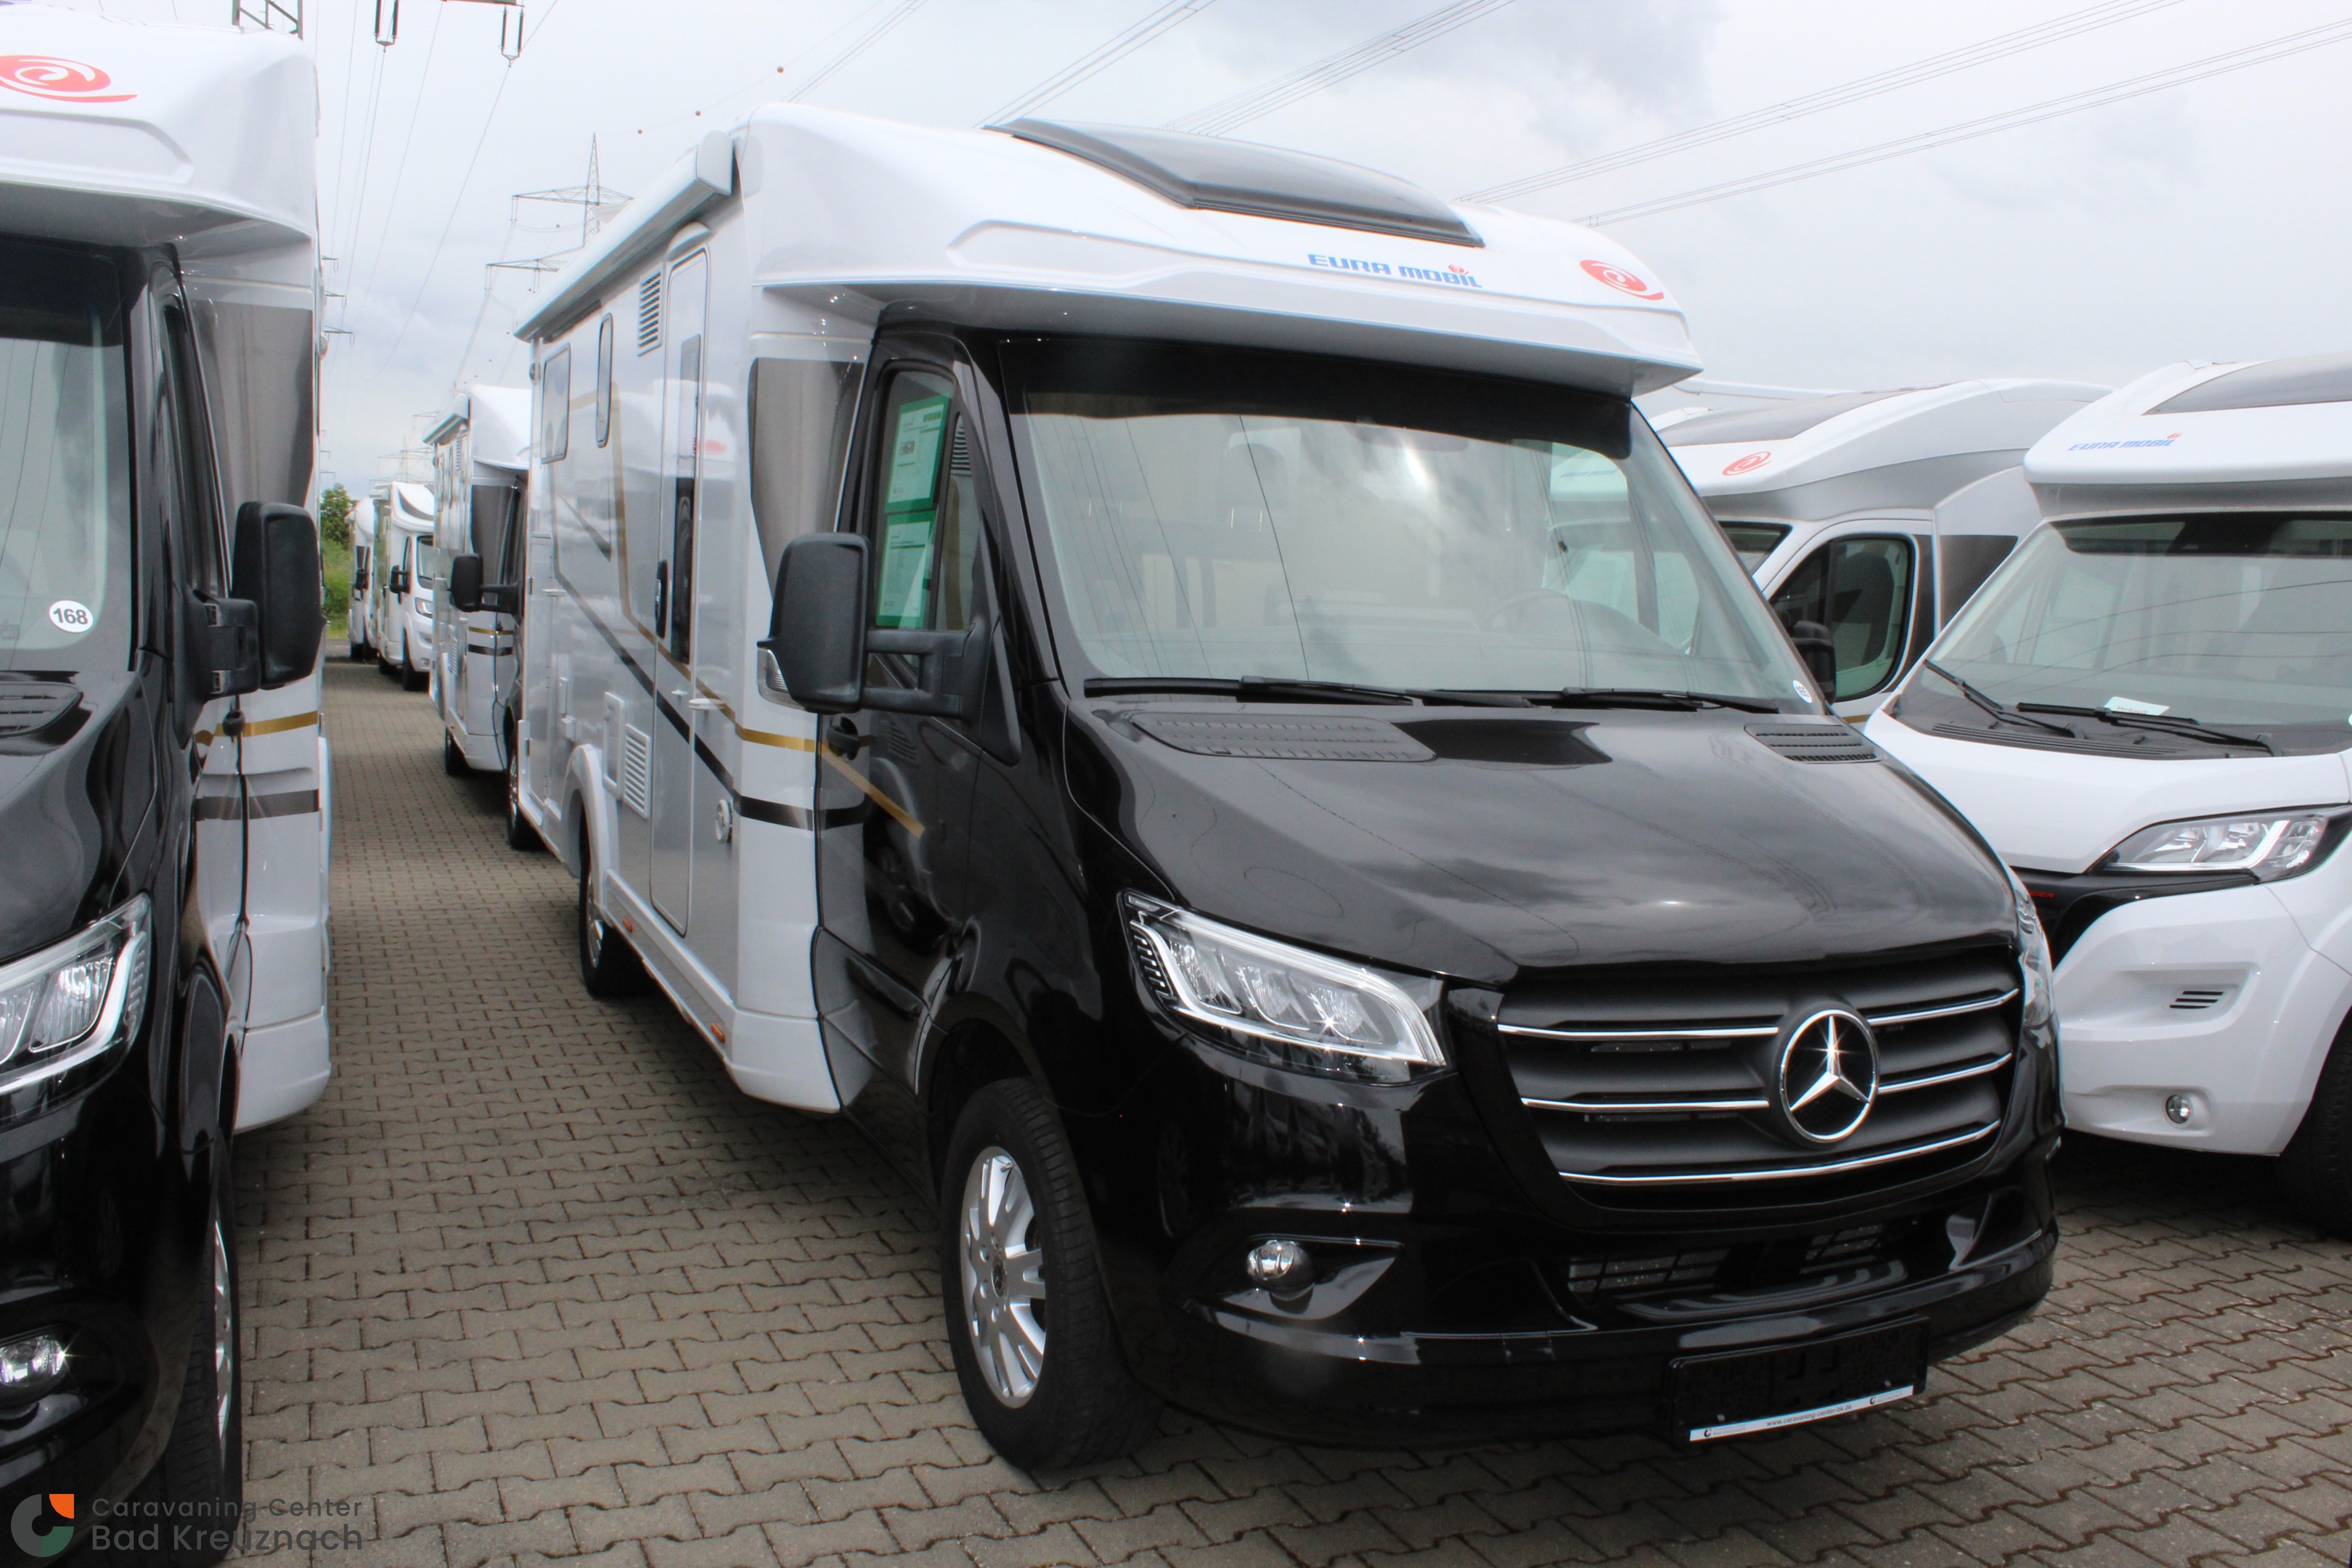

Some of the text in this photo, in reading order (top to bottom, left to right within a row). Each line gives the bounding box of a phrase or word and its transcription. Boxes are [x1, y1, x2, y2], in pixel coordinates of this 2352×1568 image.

[1307, 253, 1483, 288] EURA MOBIL
[53, 608, 89, 625] 168
